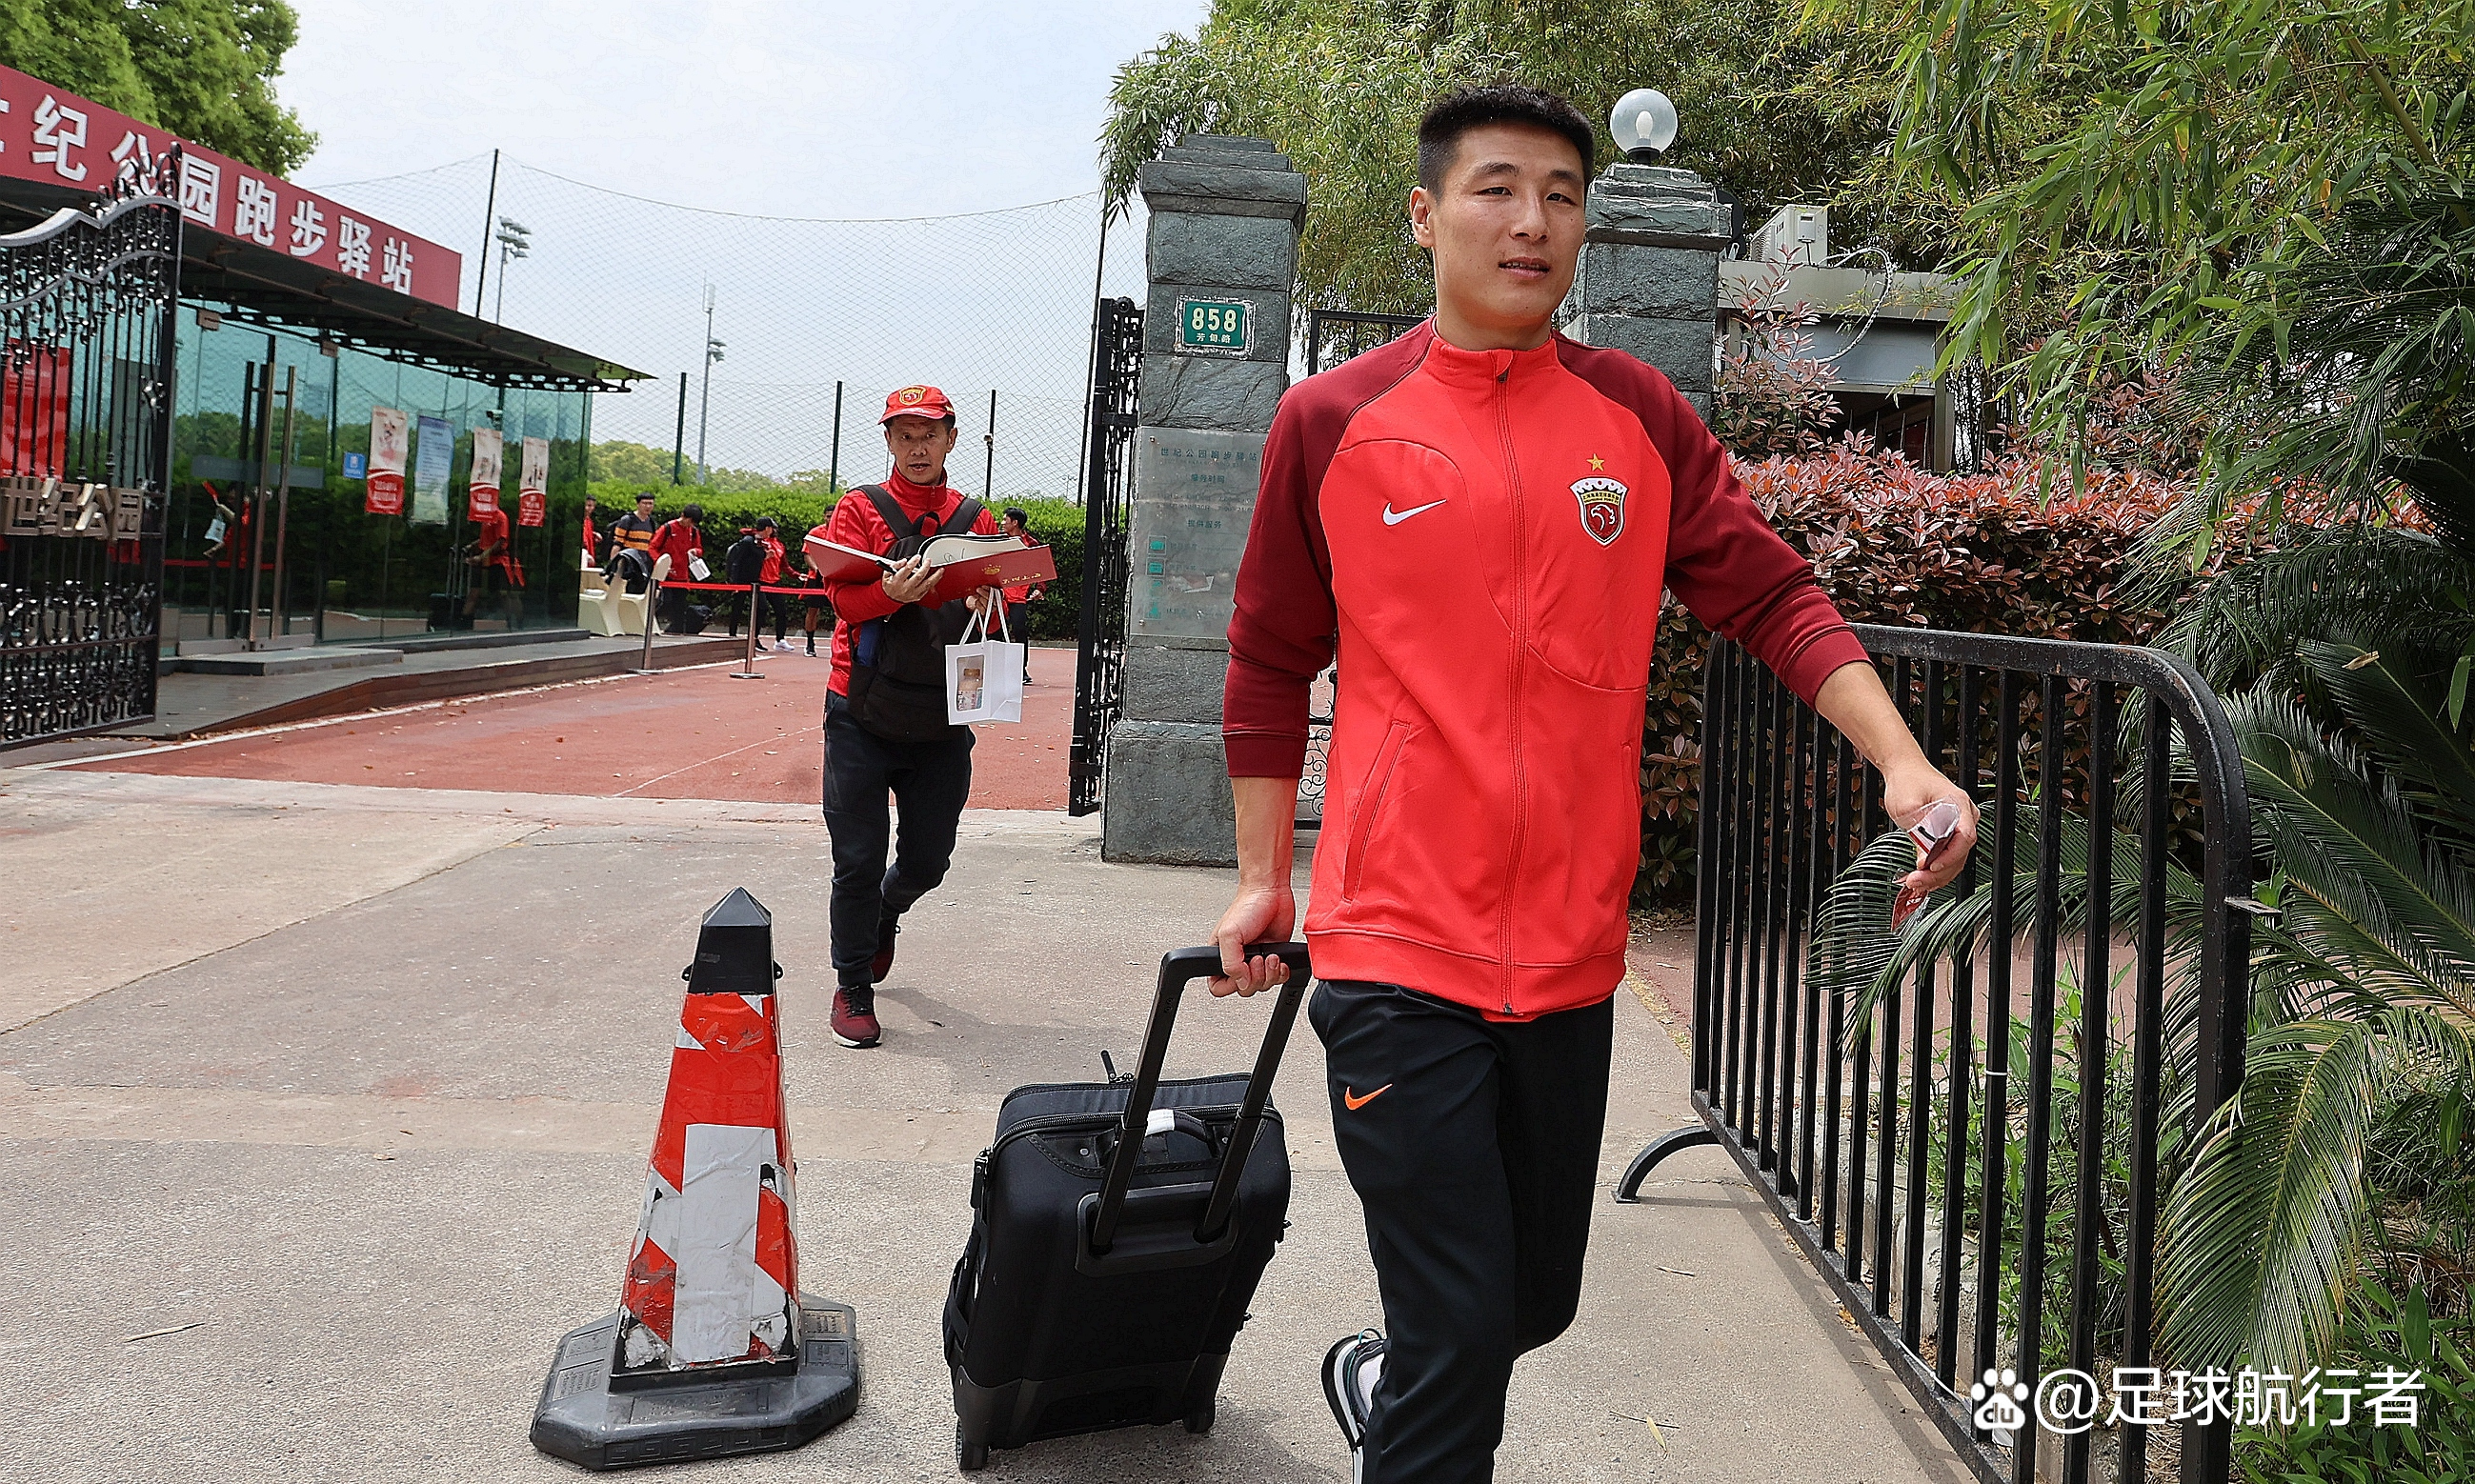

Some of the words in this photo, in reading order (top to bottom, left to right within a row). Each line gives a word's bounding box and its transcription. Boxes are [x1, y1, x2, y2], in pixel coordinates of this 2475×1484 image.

[0, 93, 414, 296] 纪公园跑步驿站
[1192, 307, 1237, 332] 858
[1196, 332, 1231, 343] 芳甸路
[1160, 447, 1258, 462] 世纪公园跑步驿站
[1187, 519, 1222, 530] 提供服务
